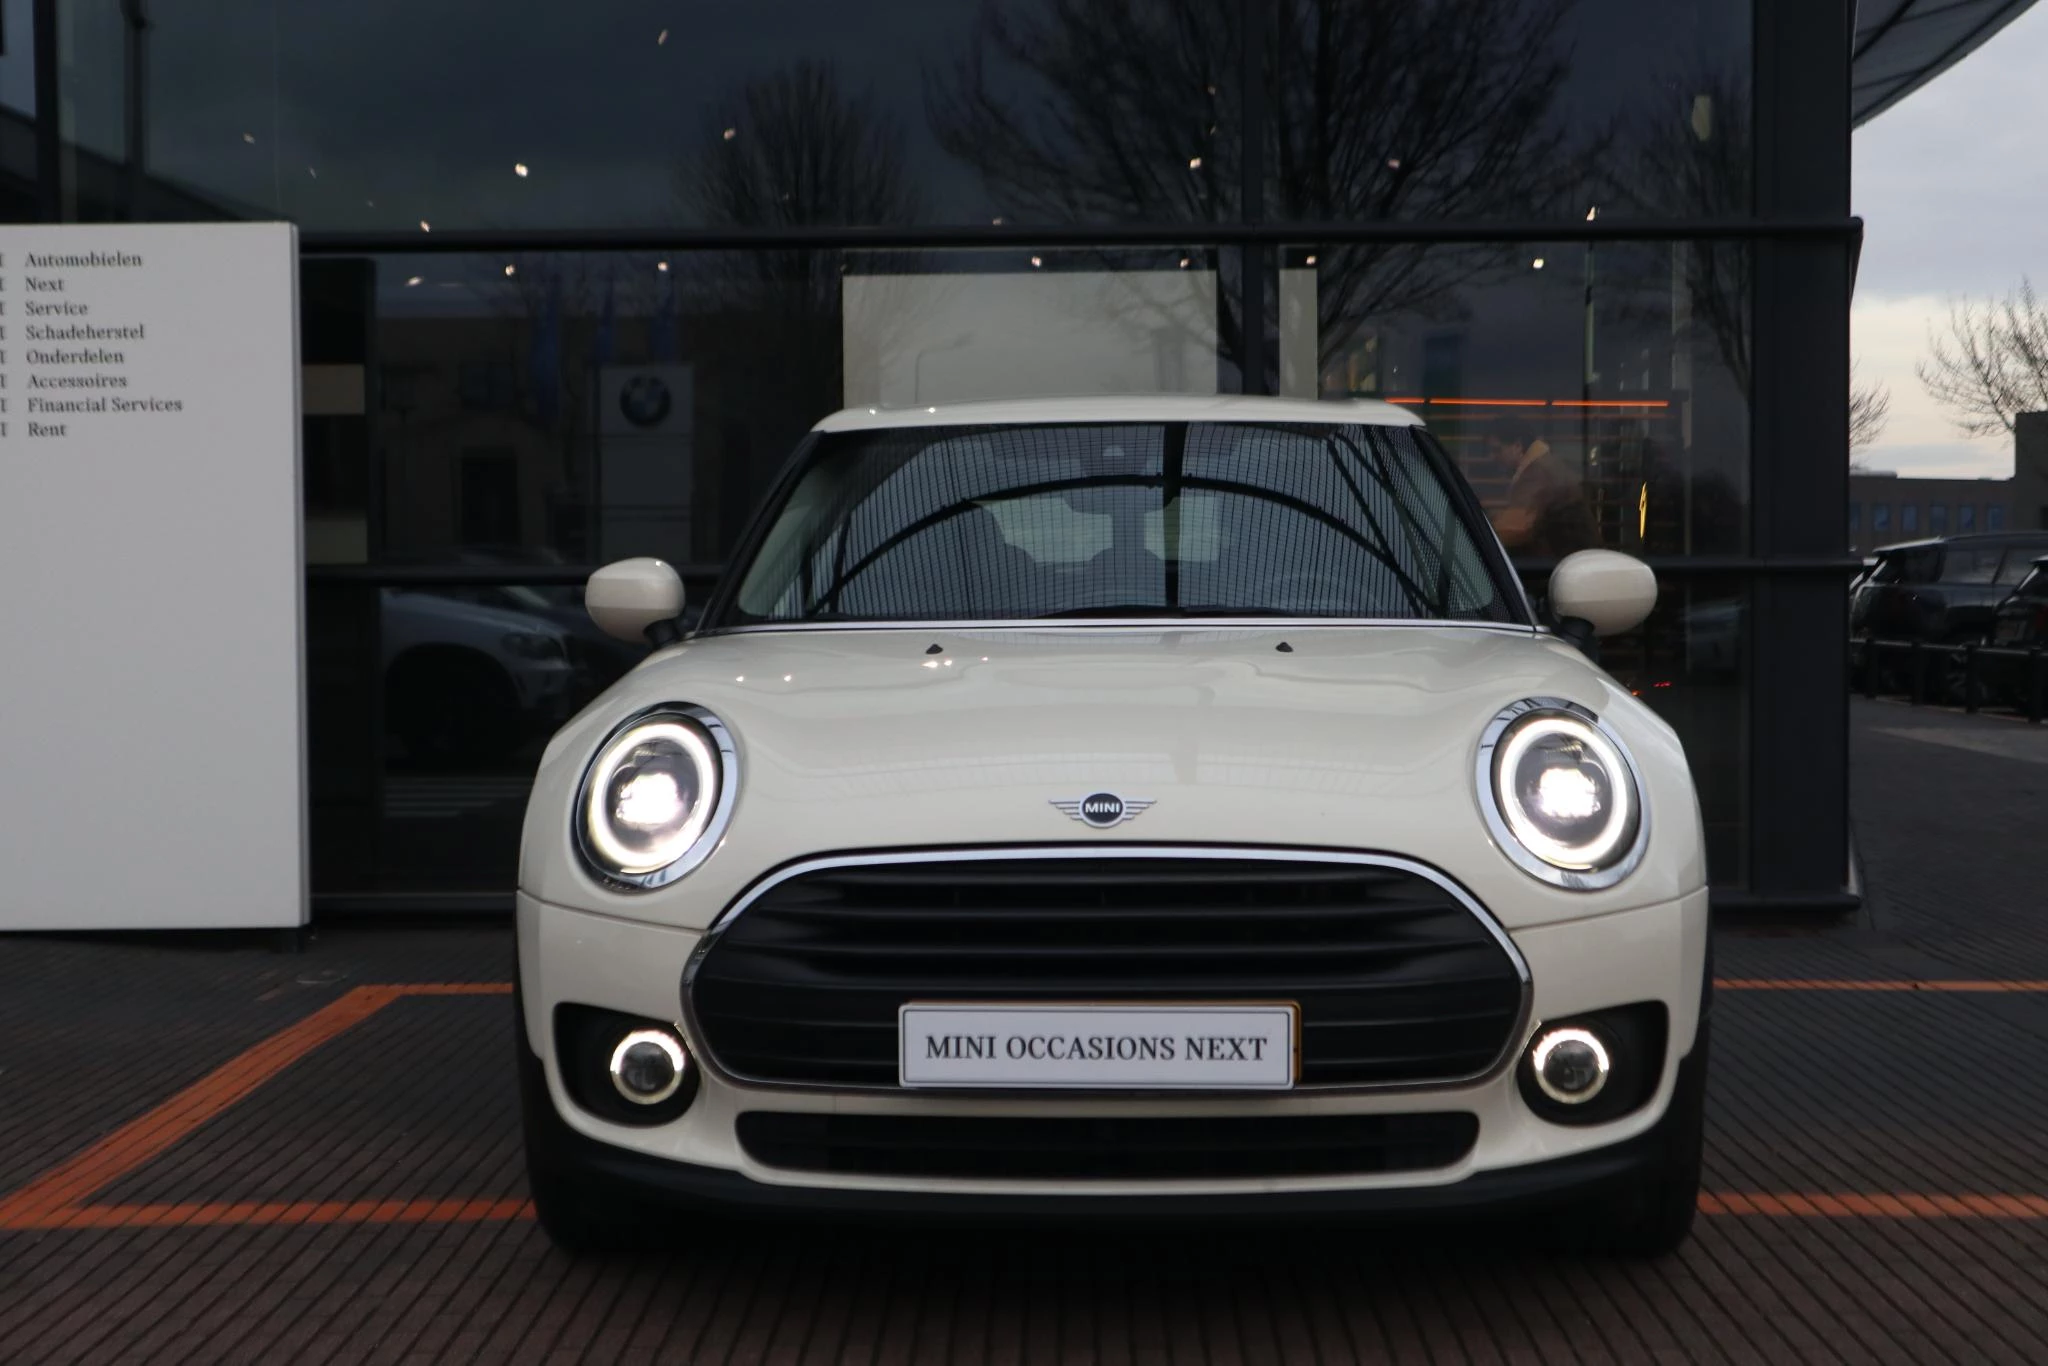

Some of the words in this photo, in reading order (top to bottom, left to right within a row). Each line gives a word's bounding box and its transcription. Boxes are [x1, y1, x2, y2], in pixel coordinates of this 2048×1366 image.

[25, 251, 143, 268] Automobielen
[25, 277, 65, 292] Next
[25, 301, 88, 316] Service
[26, 324, 145, 340] Schadeherstel
[26, 348, 125, 365] Onderdelen
[27, 373, 128, 389] Accessoires
[28, 397, 107, 413] Financial
[111, 397, 183, 413] Services
[28, 422, 67, 437] Rent
[1085, 802, 1120, 813] MINI
[926, 1035, 997, 1059] MINI
[1005, 1036, 1175, 1060] OCCASIONS
[1185, 1037, 1268, 1061] NEXT
